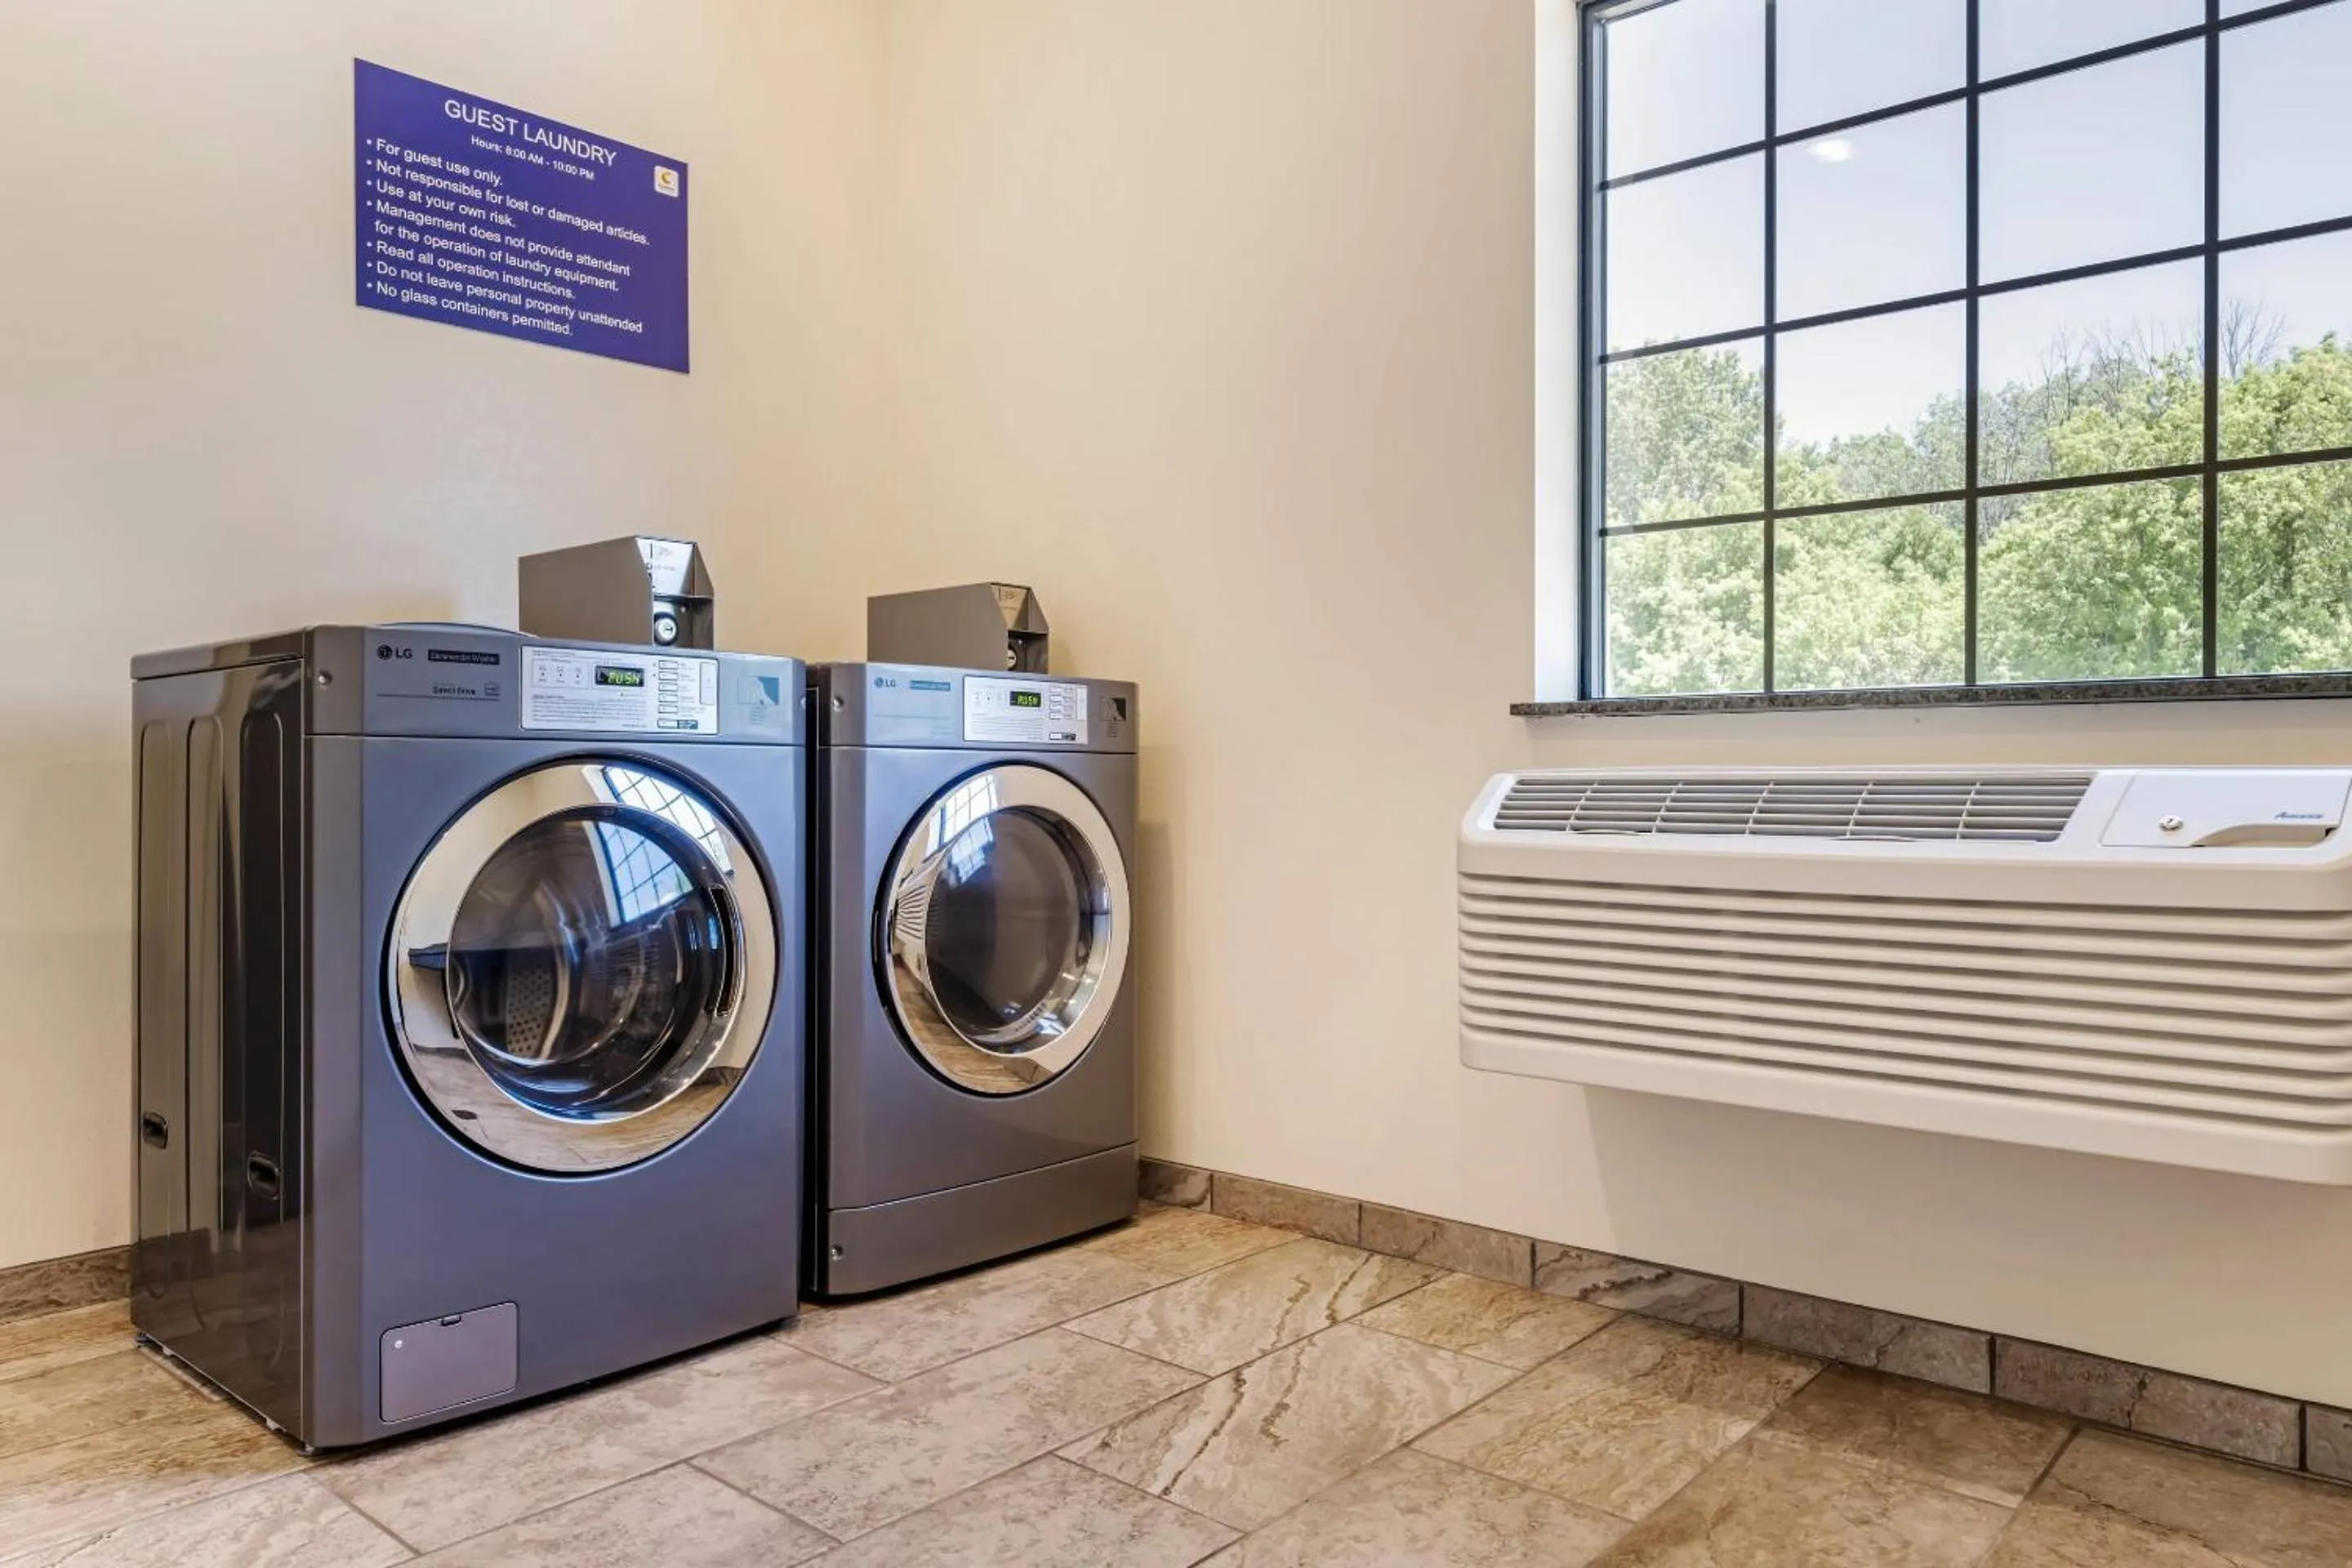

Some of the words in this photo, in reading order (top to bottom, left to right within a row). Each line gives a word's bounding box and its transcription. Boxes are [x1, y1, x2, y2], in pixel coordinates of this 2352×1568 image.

[376, 136, 401, 156] For
[403, 149, 443, 169] guest
[445, 160, 470, 176] use
[472, 168, 503, 188] only.
[443, 99, 519, 136] GUEST
[523, 122, 617, 167] LAUNDRY
[504, 145, 527, 160] 8:00
[527, 152, 544, 166] AM
[551, 159, 578, 176] 10:00
[578, 167, 595, 180] PM
[375, 158, 402, 178] Not
[404, 168, 483, 199] responsible
[484, 188, 504, 205] for
[505, 194, 530, 213] lost
[531, 204, 546, 216] or
[546, 207, 604, 234] damaged
[605, 225, 650, 246] articles.
[376, 178, 405, 198] Use
[408, 189, 422, 203] at
[425, 194, 457, 212] your
[458, 203, 486, 220] own
[489, 210, 516, 228] risk.
[373, 219, 394, 236] for
[397, 225, 420, 243] the
[422, 234, 486, 259] operation
[488, 249, 503, 263] of
[505, 252, 552, 277] laundry
[553, 266, 619, 292] equipment.
[376, 198, 467, 234] Management
[468, 225, 501, 243] does
[504, 235, 525, 249] not
[527, 240, 573, 261] provide
[575, 253, 630, 277] attendant
[376, 239, 415, 261] Read
[417, 252, 434, 265] all
[436, 257, 500, 282] operation
[501, 270, 576, 300] instructions.
[376, 260, 398, 277] Do
[400, 268, 424, 283] not
[425, 272, 463, 292] leave
[466, 283, 522, 305] personal
[524, 297, 576, 320] property
[577, 310, 643, 334] unattended
[376, 279, 398, 297] No
[400, 287, 439, 306] glass
[440, 297, 509, 322] containers
[511, 314, 573, 336] permitted.
[395, 648, 412, 659] LG
